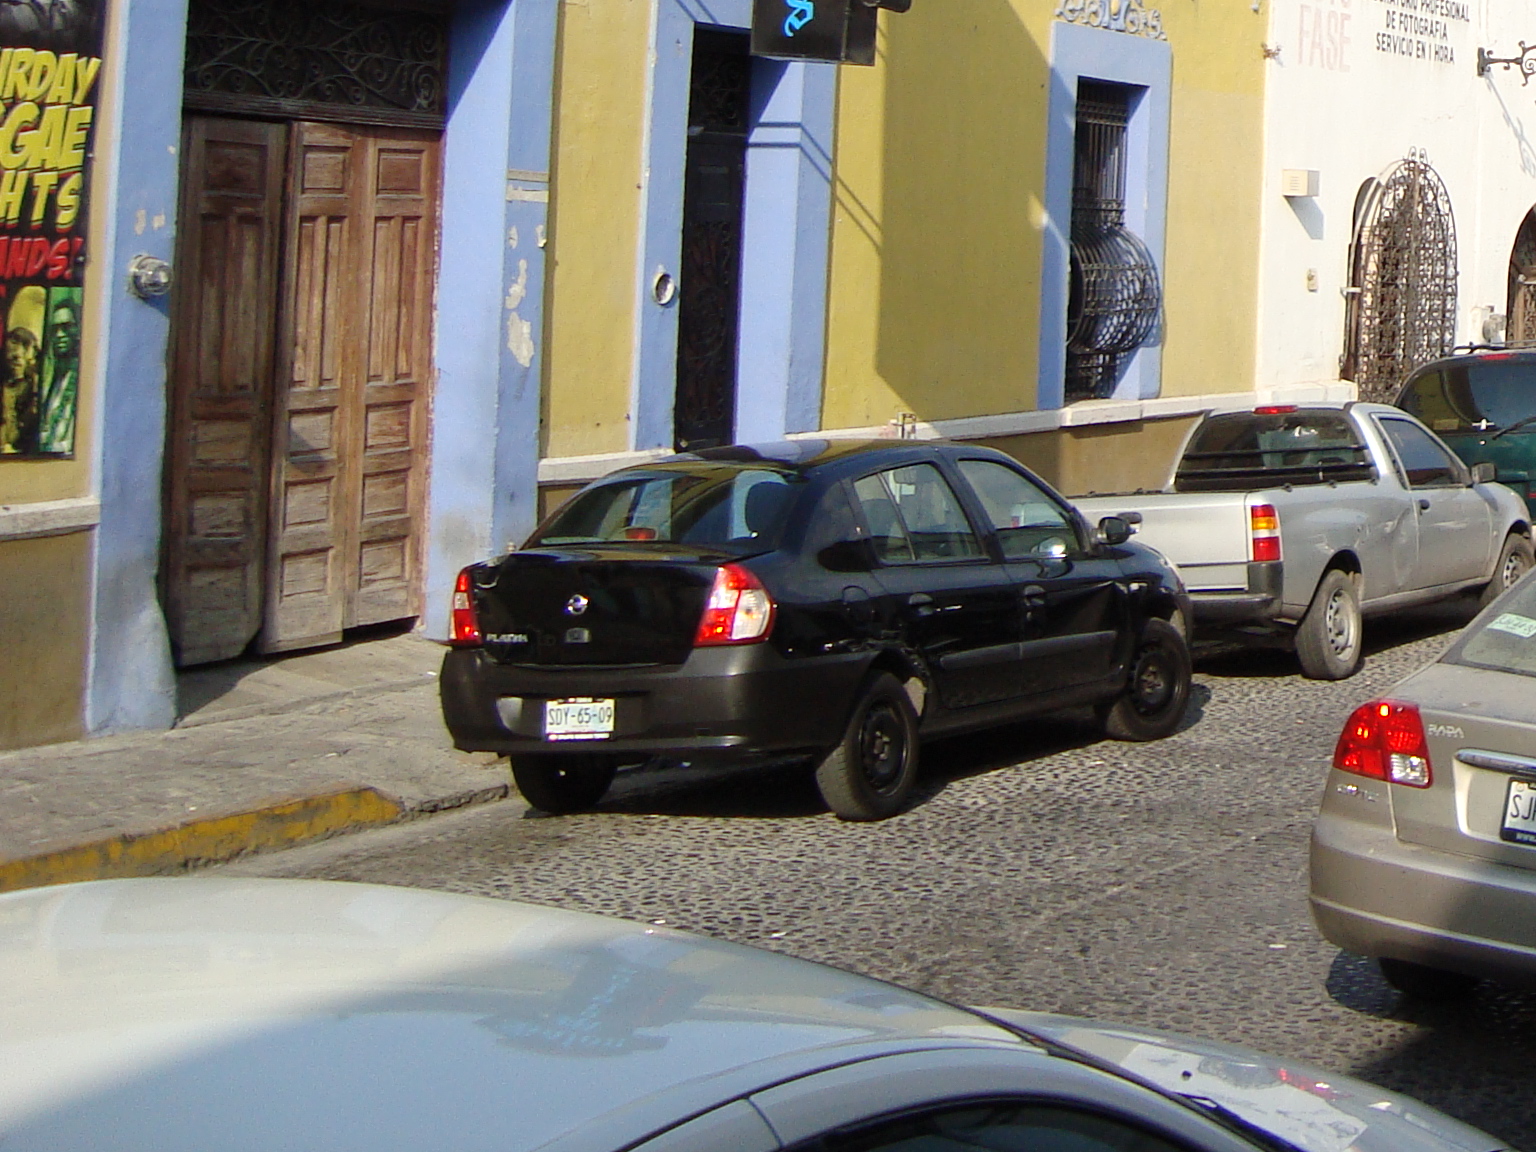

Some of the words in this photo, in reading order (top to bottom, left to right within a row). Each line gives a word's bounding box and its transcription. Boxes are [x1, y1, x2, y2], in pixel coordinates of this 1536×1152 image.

[1298, 3, 1351, 72] FASE
[1386, 9, 1396, 29] DE
[1399, 12, 1448, 41] FOTOGRAFIA
[1376, 32, 1413, 57] SERVICIO
[1416, 39, 1426, 59] EN
[1434, 43, 1455, 65] HORA
[0, 101, 93, 170] GAE
[548, 706, 613, 726] SDY-65-09
